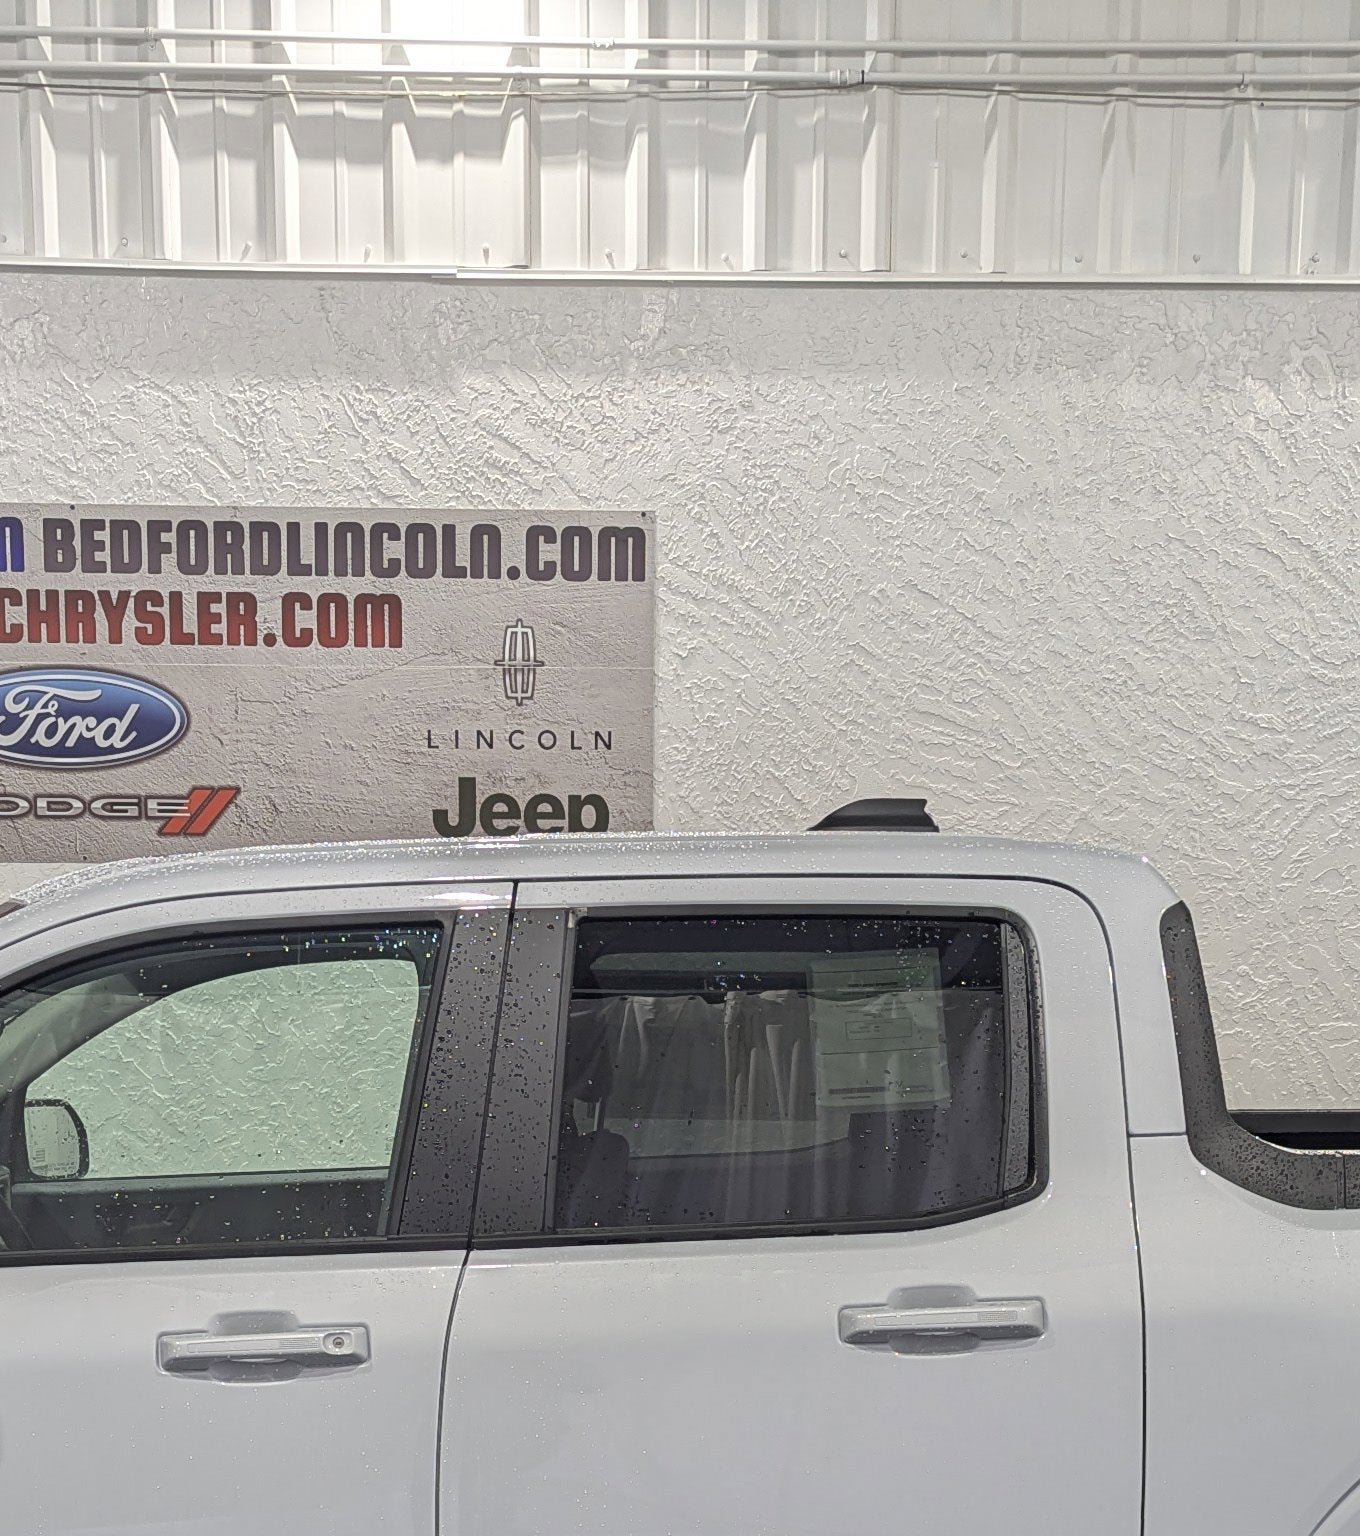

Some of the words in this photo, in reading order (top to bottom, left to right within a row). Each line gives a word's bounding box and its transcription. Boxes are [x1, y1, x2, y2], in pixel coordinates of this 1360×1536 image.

[42, 518, 647, 582] BEDFORDLINCOLN.COM
[427, 729, 613, 751] LINCOLN
[432, 776, 610, 838] Jeep
